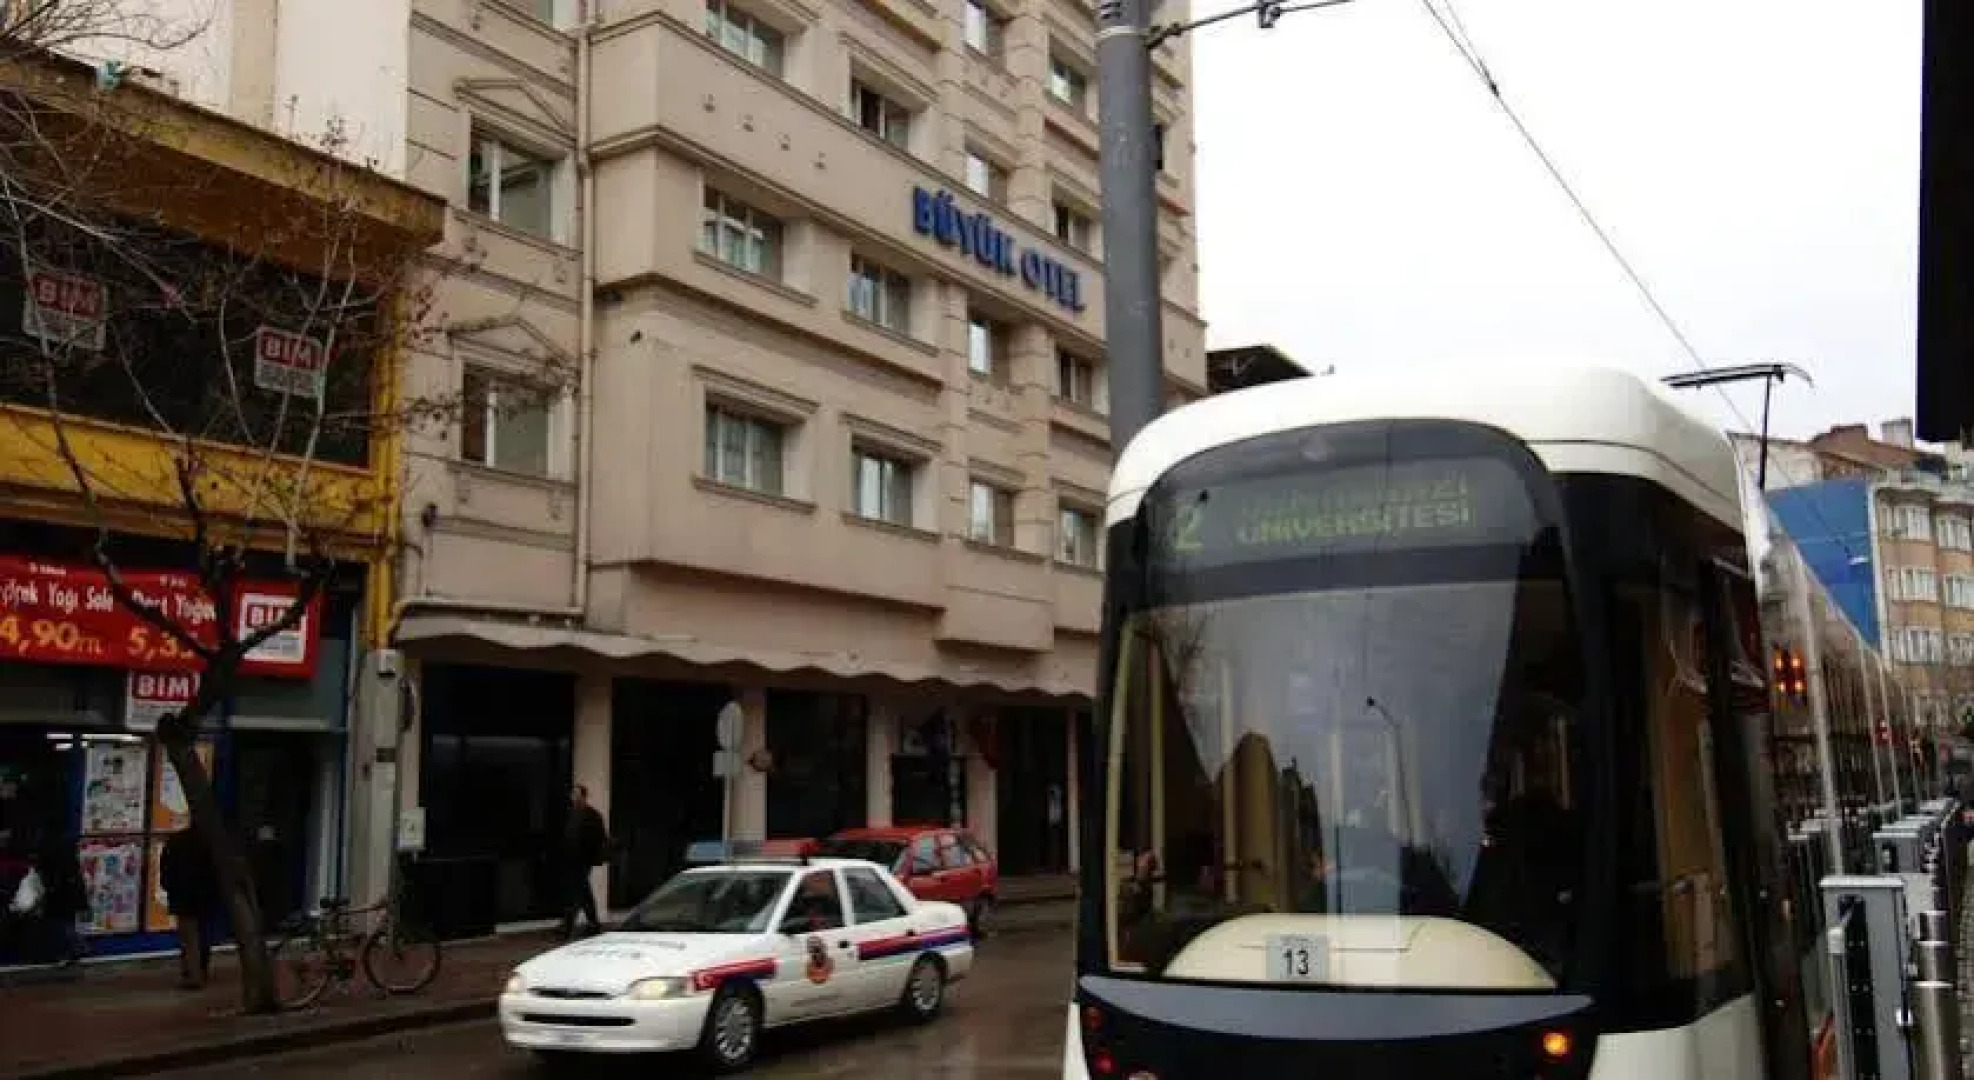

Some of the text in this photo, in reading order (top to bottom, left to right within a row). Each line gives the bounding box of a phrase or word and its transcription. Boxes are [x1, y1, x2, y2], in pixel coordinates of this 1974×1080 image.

[913, 185, 1087, 313] BÜYÜK OTEL
[1282, 948, 1309, 975] 13
